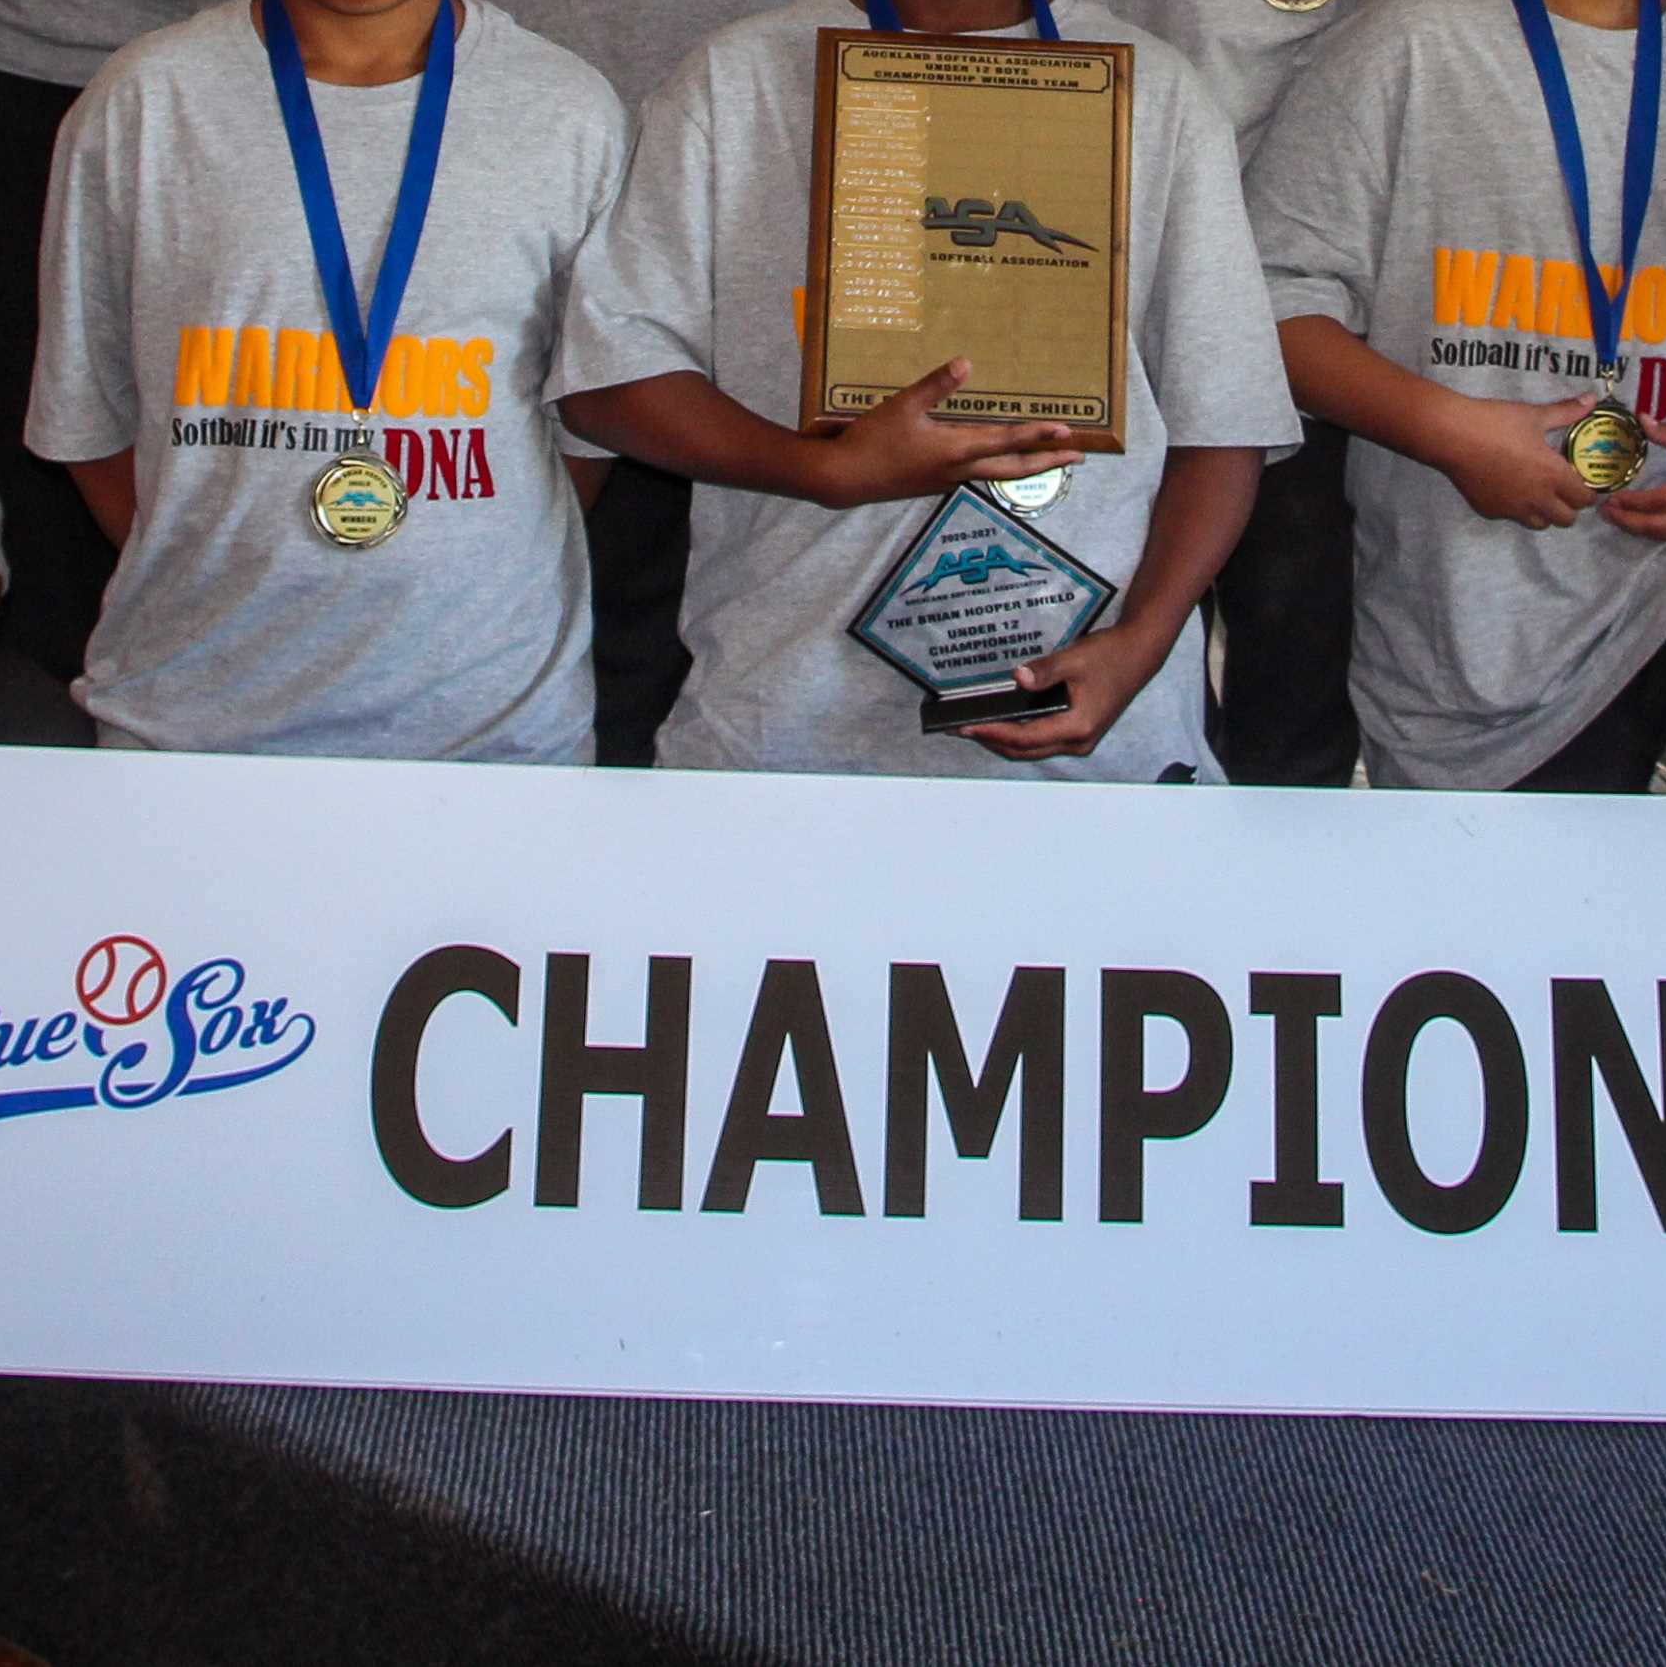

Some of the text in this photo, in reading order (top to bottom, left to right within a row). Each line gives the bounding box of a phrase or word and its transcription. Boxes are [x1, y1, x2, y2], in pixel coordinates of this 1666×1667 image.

[862, 49, 1092, 70] AUCKLAND SOFTBALL ASSOCIATION
[925, 63, 1029, 76] UNDER 12 BOYS
[874, 70, 1080, 88] CHAMPIONSHIP WINNING TEAM
[1002, 256, 1090, 269] ASSOCIATION
[1431, 337, 1519, 370] Softball
[1525, 346, 1561, 375] it's
[1566, 350, 1591, 378] in
[840, 392, 874, 406] THE
[946, 397, 1022, 414] HOOPER
[1029, 402, 1096, 417] SHIELD
[171, 416, 258, 449] Softball
[259, 414, 297, 451] it's
[301, 421, 329, 453] in
[383, 428, 496, 501] DNA
[886, 591, 1075, 630] THE BRIAN HOOPER SHIELD
[947, 619, 1020, 640] UNDER 12
[928, 630, 1044, 657] CHAMPIONSHIP
[934, 645, 1044, 671] WINNING TEAM
[99, 958, 293, 1110] Sox
